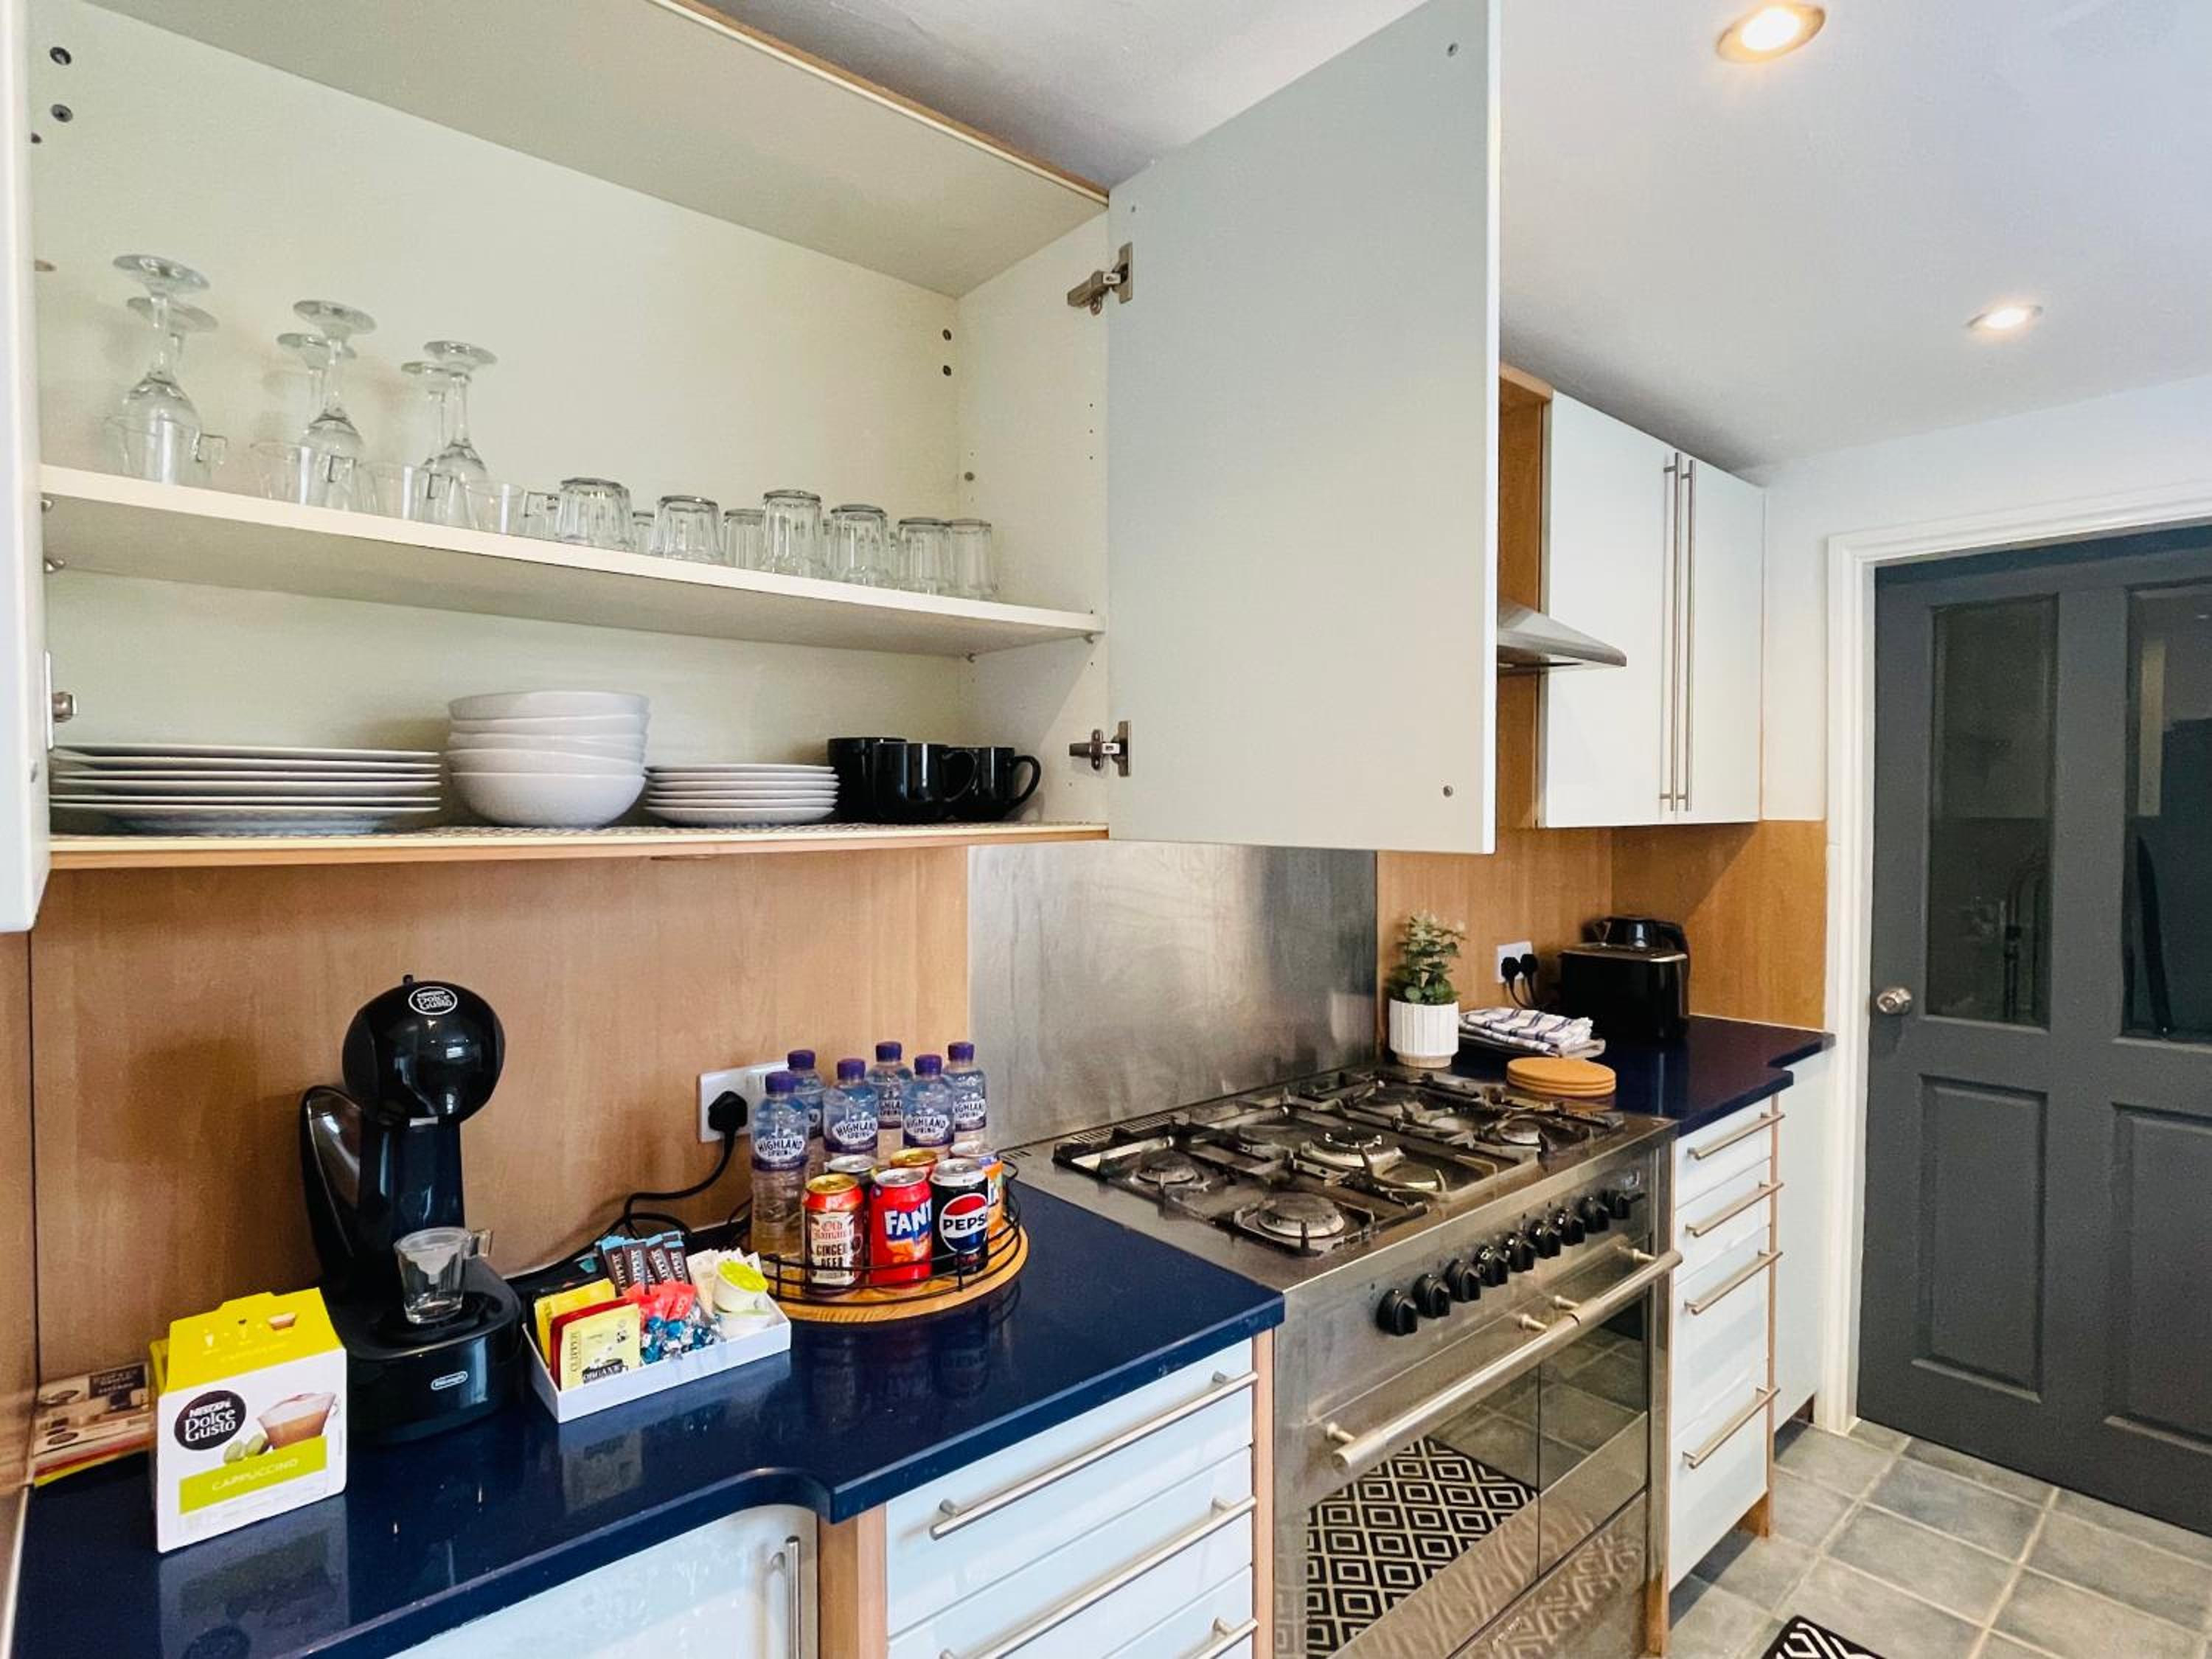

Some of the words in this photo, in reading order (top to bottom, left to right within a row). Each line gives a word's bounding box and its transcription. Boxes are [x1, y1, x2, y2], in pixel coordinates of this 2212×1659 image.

[757, 1138, 803, 1152] HIGHLAND
[884, 1197, 932, 1236] FANT
[943, 1213, 987, 1231] PEPS
[185, 1409, 236, 1433] Dolce
[185, 1420, 236, 1441] Gusto
